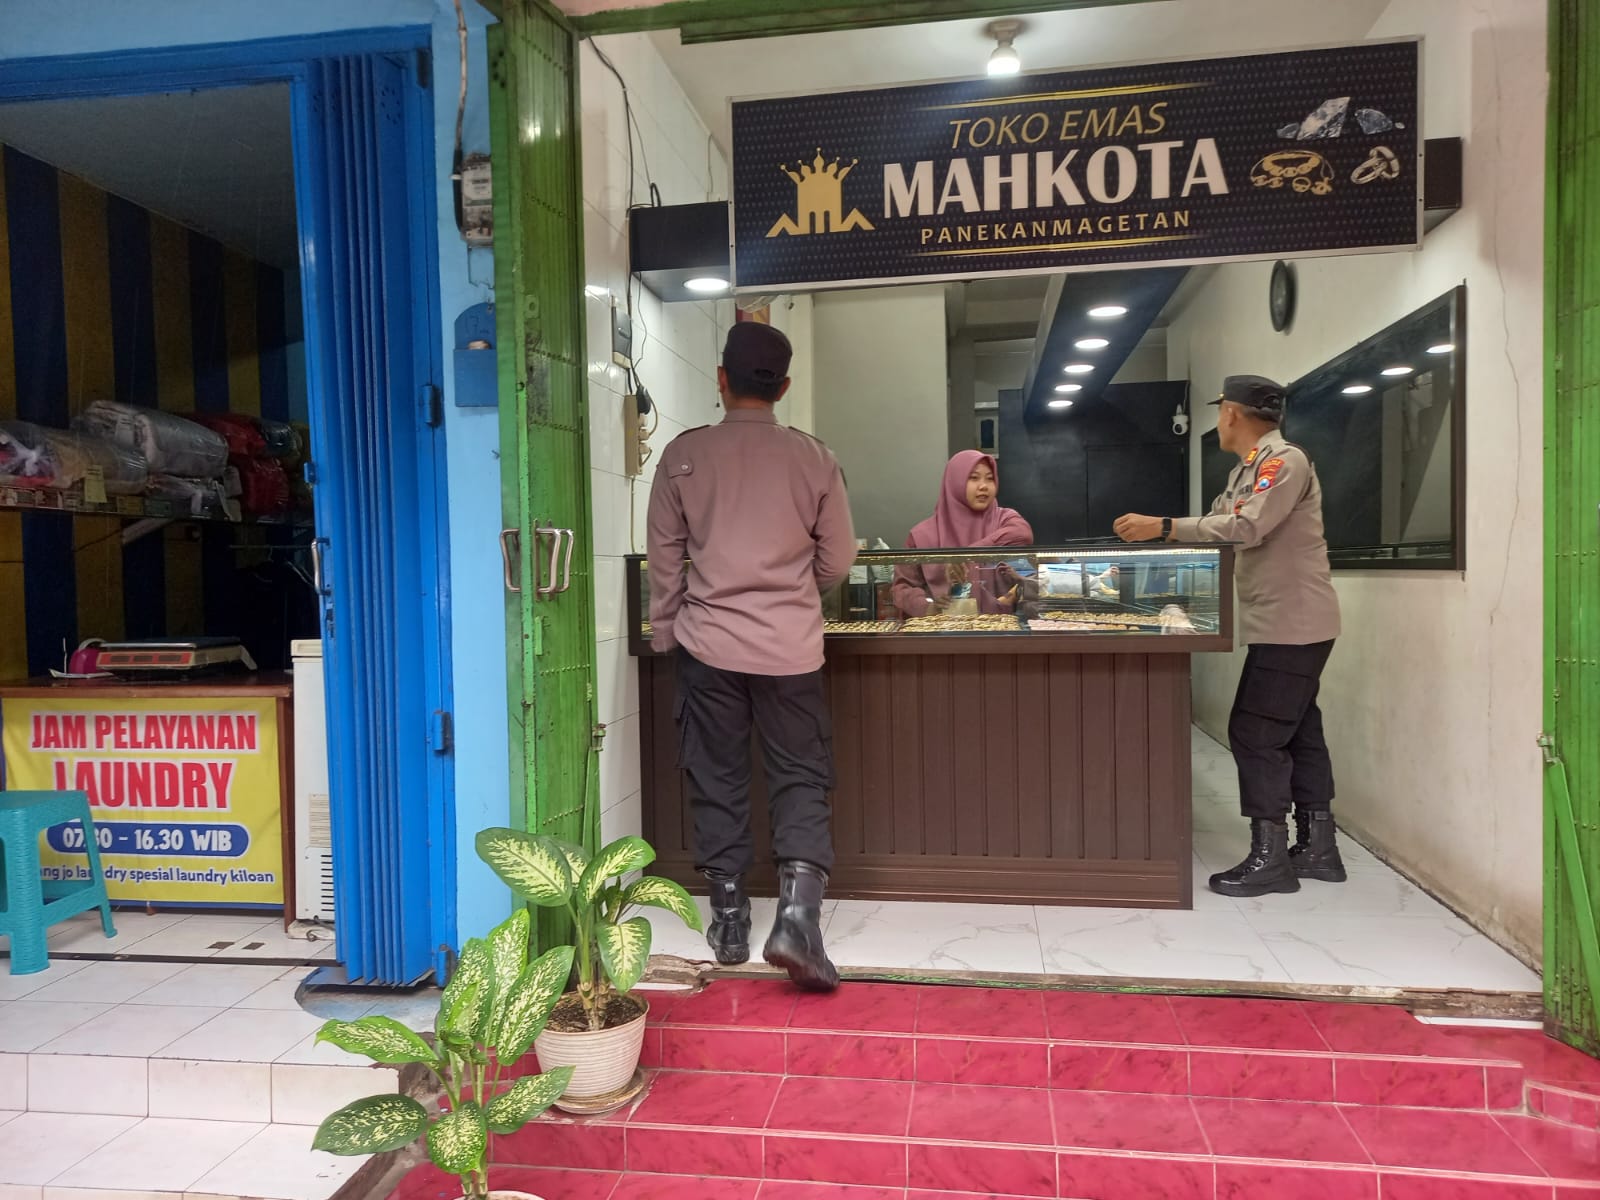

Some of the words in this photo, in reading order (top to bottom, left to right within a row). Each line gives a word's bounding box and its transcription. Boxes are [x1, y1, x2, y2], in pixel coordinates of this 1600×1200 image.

[950, 112, 1049, 149] TOKO
[1059, 102, 1168, 141] EMAS
[884, 138, 1230, 219] MAHKOTA
[921, 210, 1190, 245] PANEKANMAGETAN
[32, 715, 87, 749] JAM
[95, 715, 256, 749] PELAYANAN
[134, 829, 184, 850] 16.30
[190, 829, 232, 851] WIB
[62, 864, 73, 880] jo
[130, 867, 173, 882] spesial
[177, 867, 227, 885] laundry
[230, 869, 274, 883] kiloan
